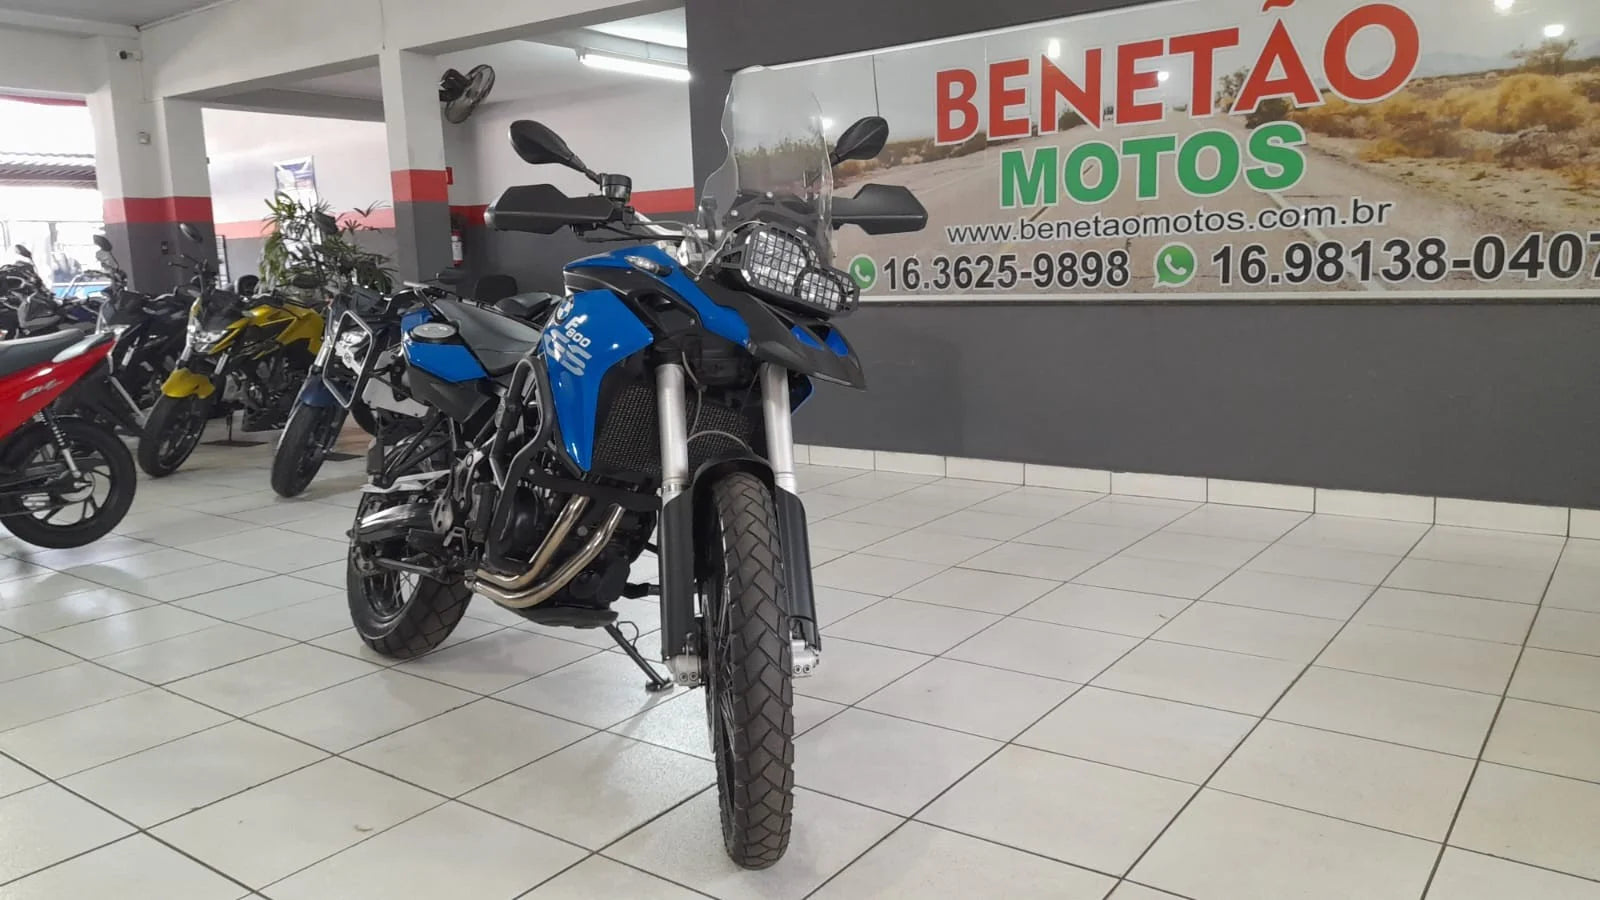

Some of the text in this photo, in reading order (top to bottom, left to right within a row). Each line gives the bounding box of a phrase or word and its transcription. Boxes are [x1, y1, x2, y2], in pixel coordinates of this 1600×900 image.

[936, 0, 1419, 143] BENETÃO
[1001, 124, 1304, 207] MOTOS
[947, 200, 1390, 243] www.benetaomotos.com.br
[884, 251, 1128, 289] 16.3625-9898
